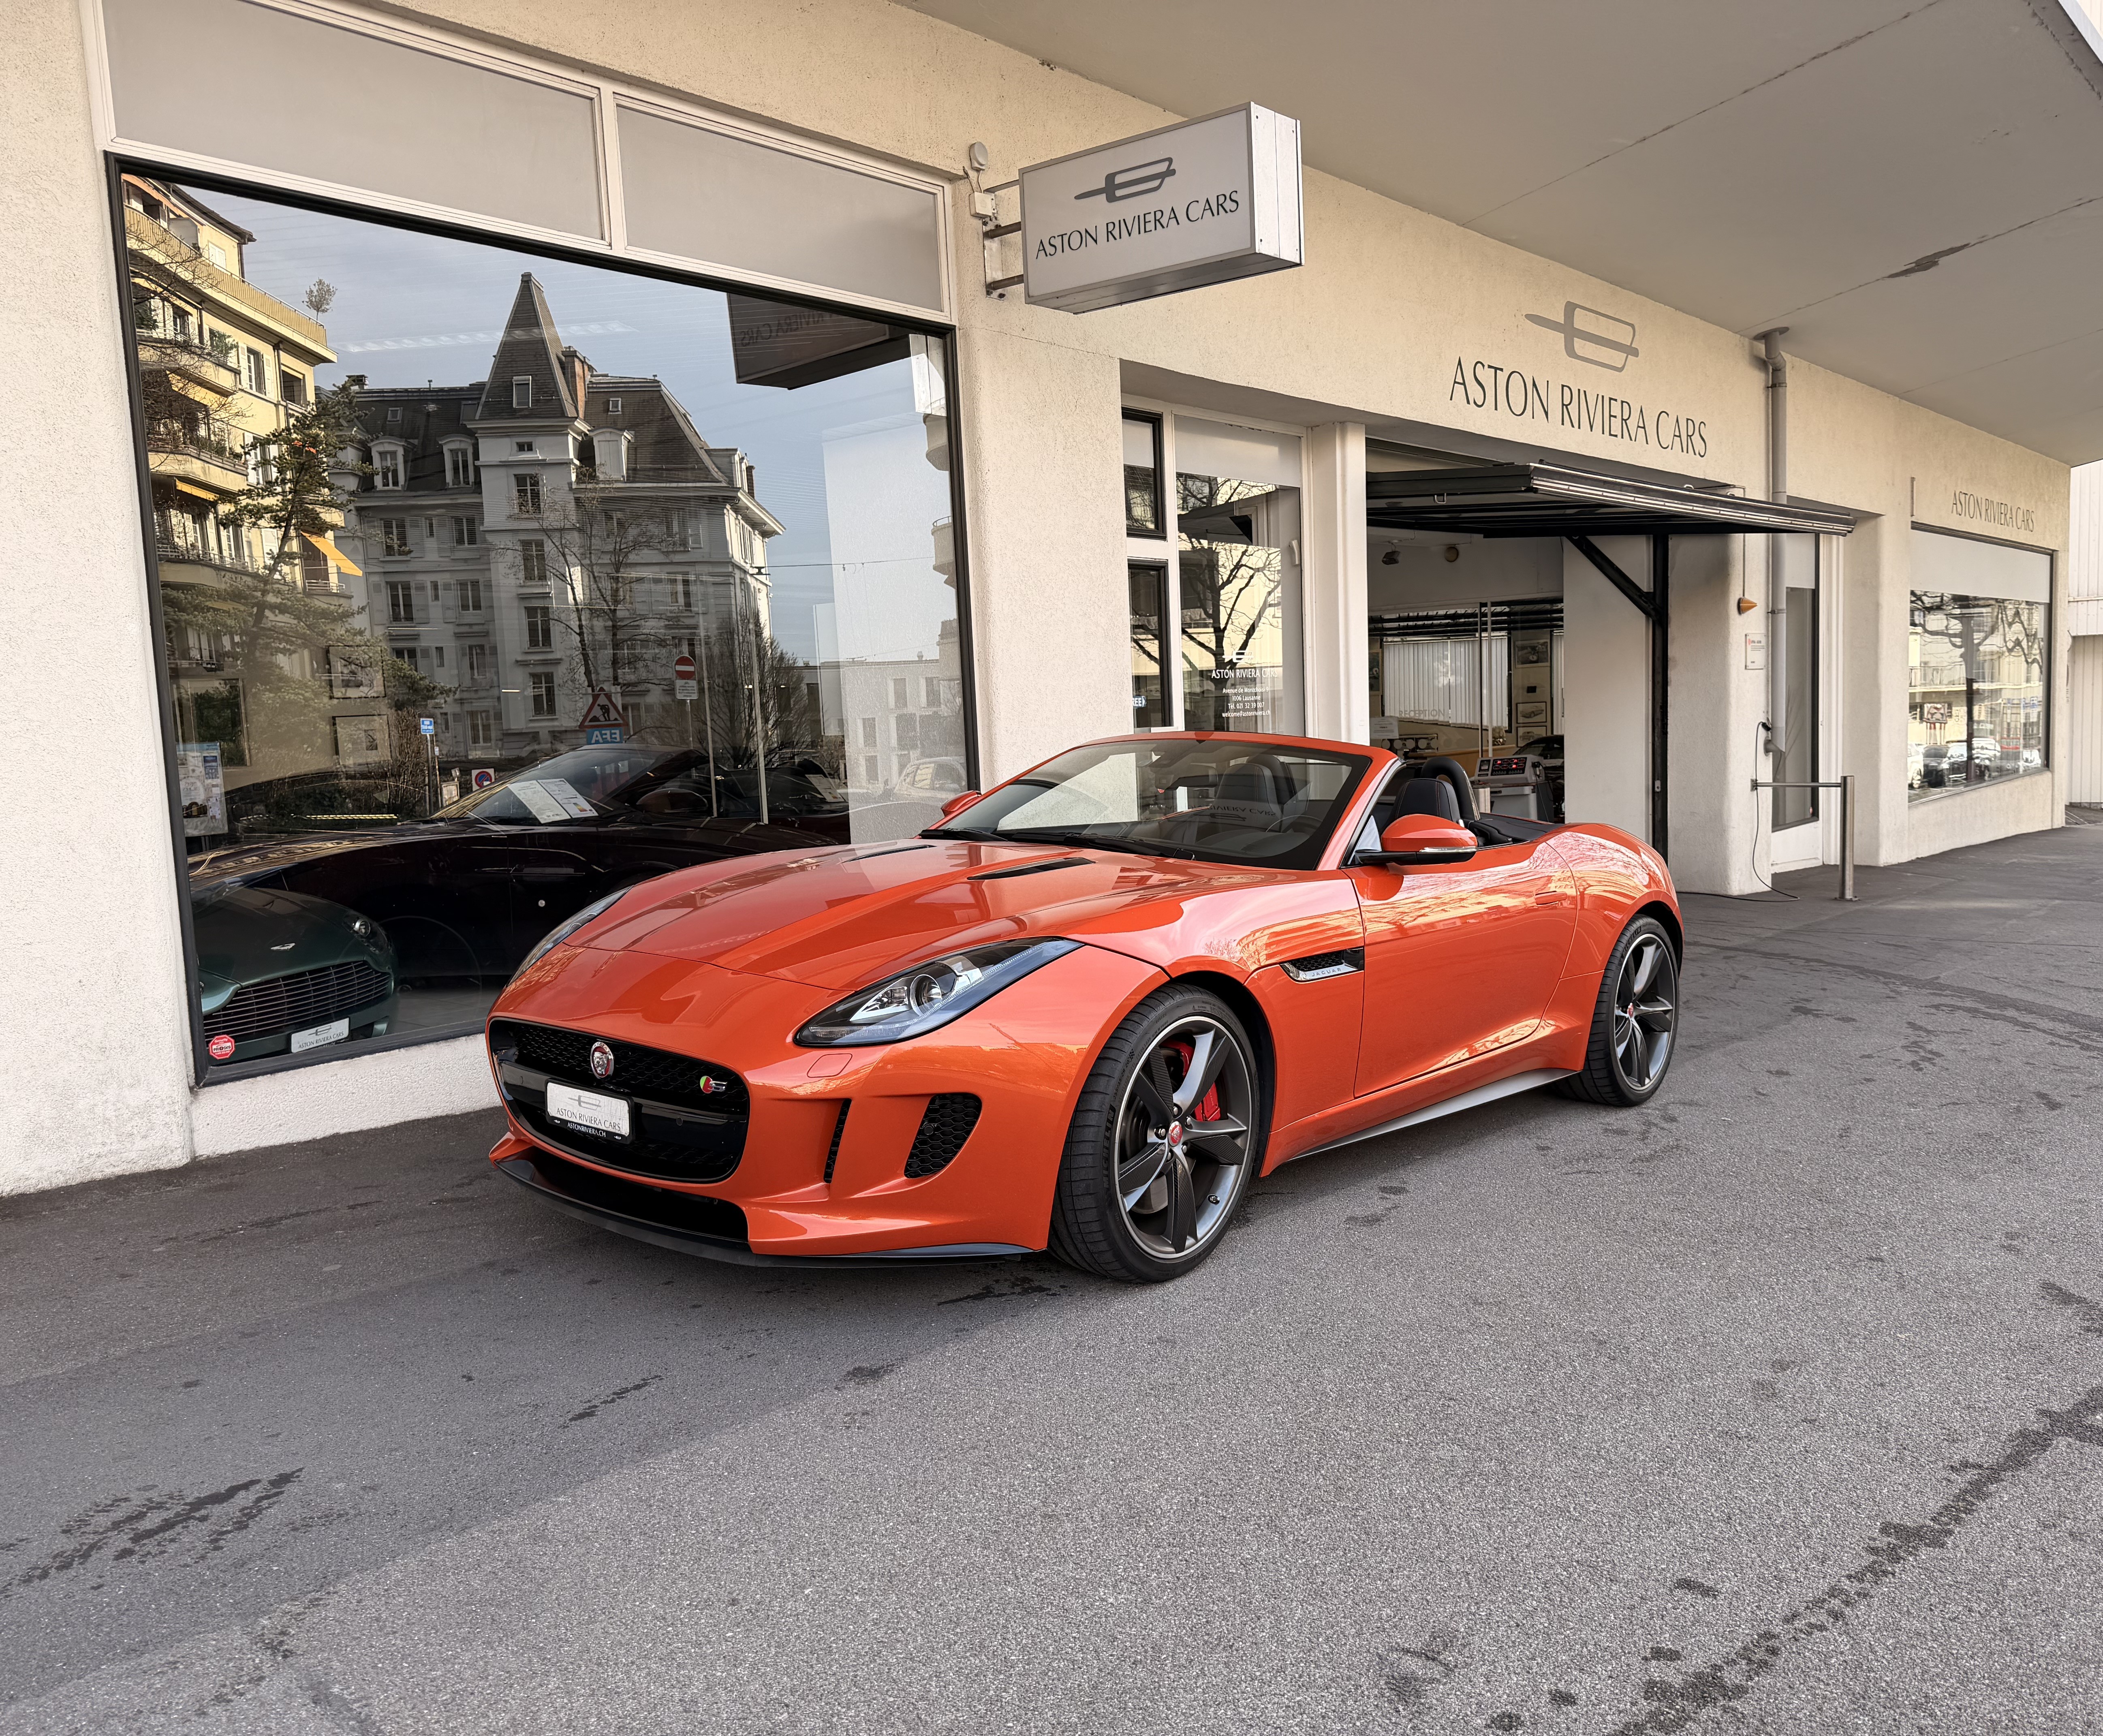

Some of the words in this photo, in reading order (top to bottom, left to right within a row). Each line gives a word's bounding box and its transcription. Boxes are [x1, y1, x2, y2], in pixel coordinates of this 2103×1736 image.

[1036, 225, 1098, 259] ASTON
[1106, 206, 1180, 243] RIVIERA
[1186, 190, 1239, 223] CARS
[1449, 356, 1549, 423] ASTON
[1561, 384, 1649, 445] RIVIERA
[1656, 410, 1707, 458] CARS
[1951, 490, 1982, 521] ASTON
[1985, 498, 2014, 528] RIVIERA
[2016, 507, 2034, 532] CARS
[1212, 669, 1234, 678] ASTON
[1236, 669, 1261, 678] RIVIERA
[1262, 668, 1277, 677] CARS
[1399, 709, 1445, 717] RECEPTION
[1312, 968, 1342, 977] JAGUAR
[298, 1041, 315, 1049] ASTON
[316, 1035, 332, 1044] RIVIERA
[556, 1107, 577, 1119] ASTON
[579, 1113, 602, 1126] RIVIERA
[604, 1120, 621, 1132] CARS
[1103, 1108, 1115, 1189] MICHELIN
